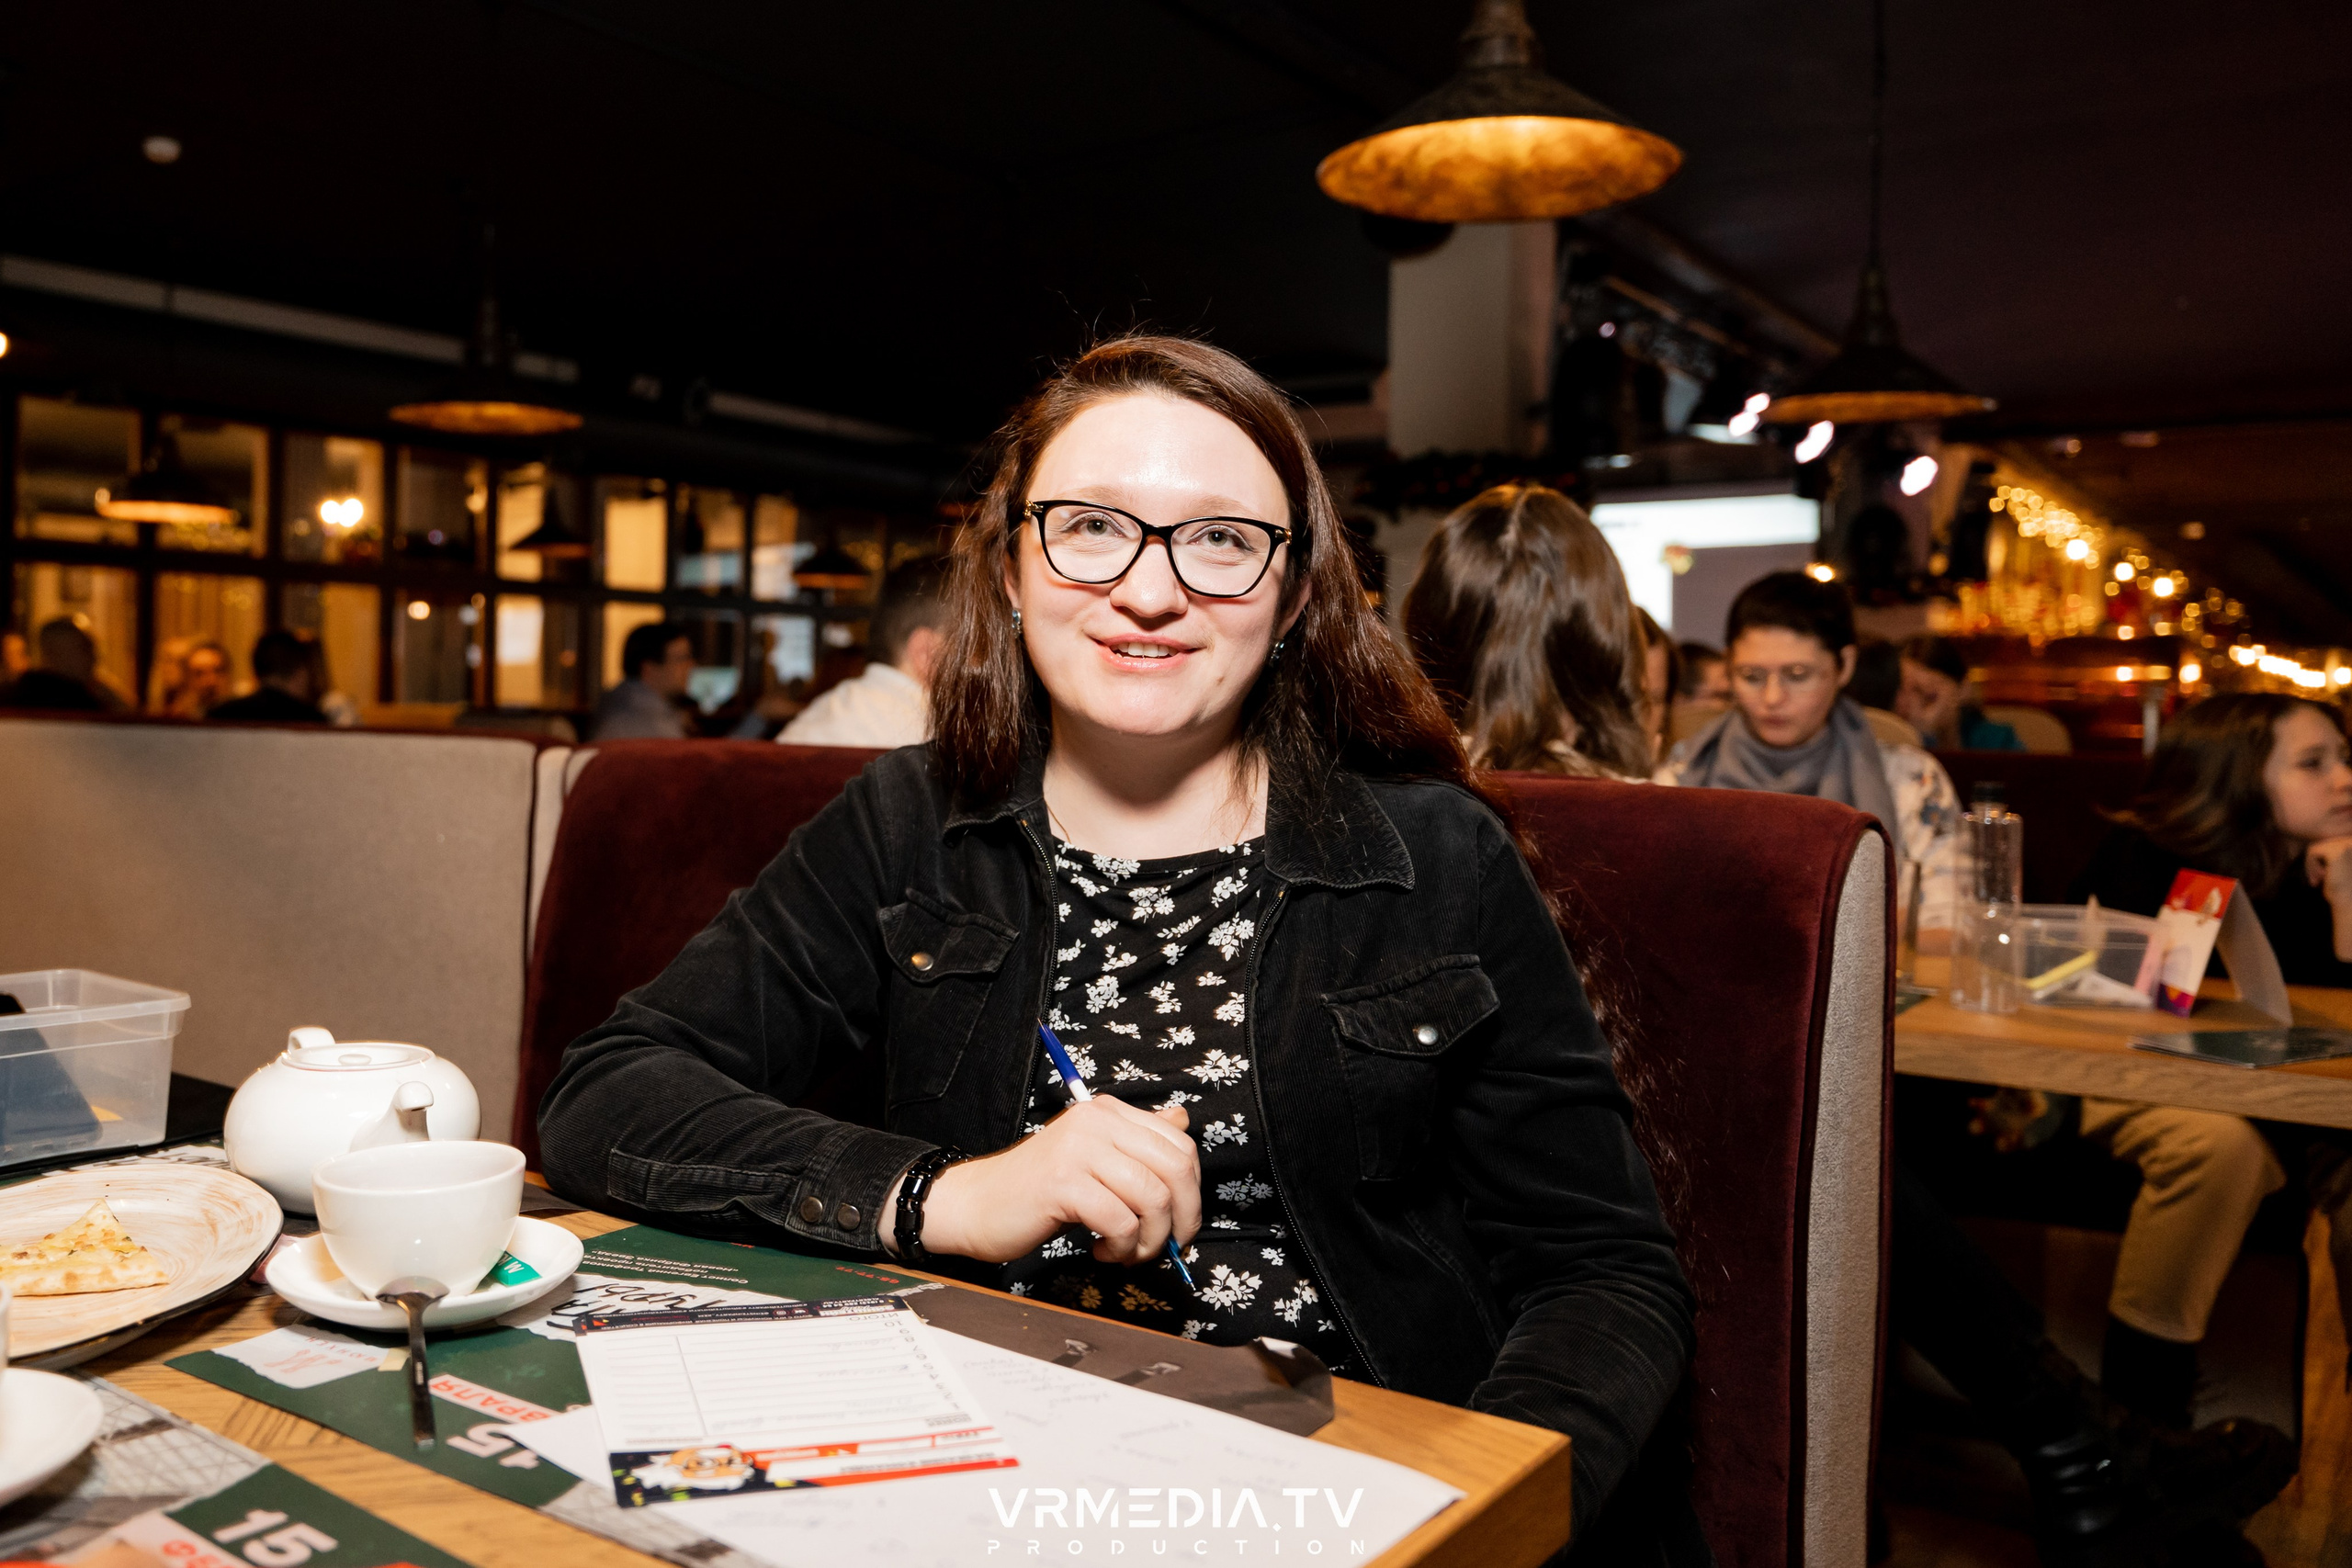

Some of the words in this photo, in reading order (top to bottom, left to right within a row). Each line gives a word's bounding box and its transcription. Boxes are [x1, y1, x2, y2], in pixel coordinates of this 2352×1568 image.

[701, 1274, 749, 1284] Солист
[429, 1380, 551, 1422] ВРАЛЯ
[212, 1509, 338, 1566] 15
